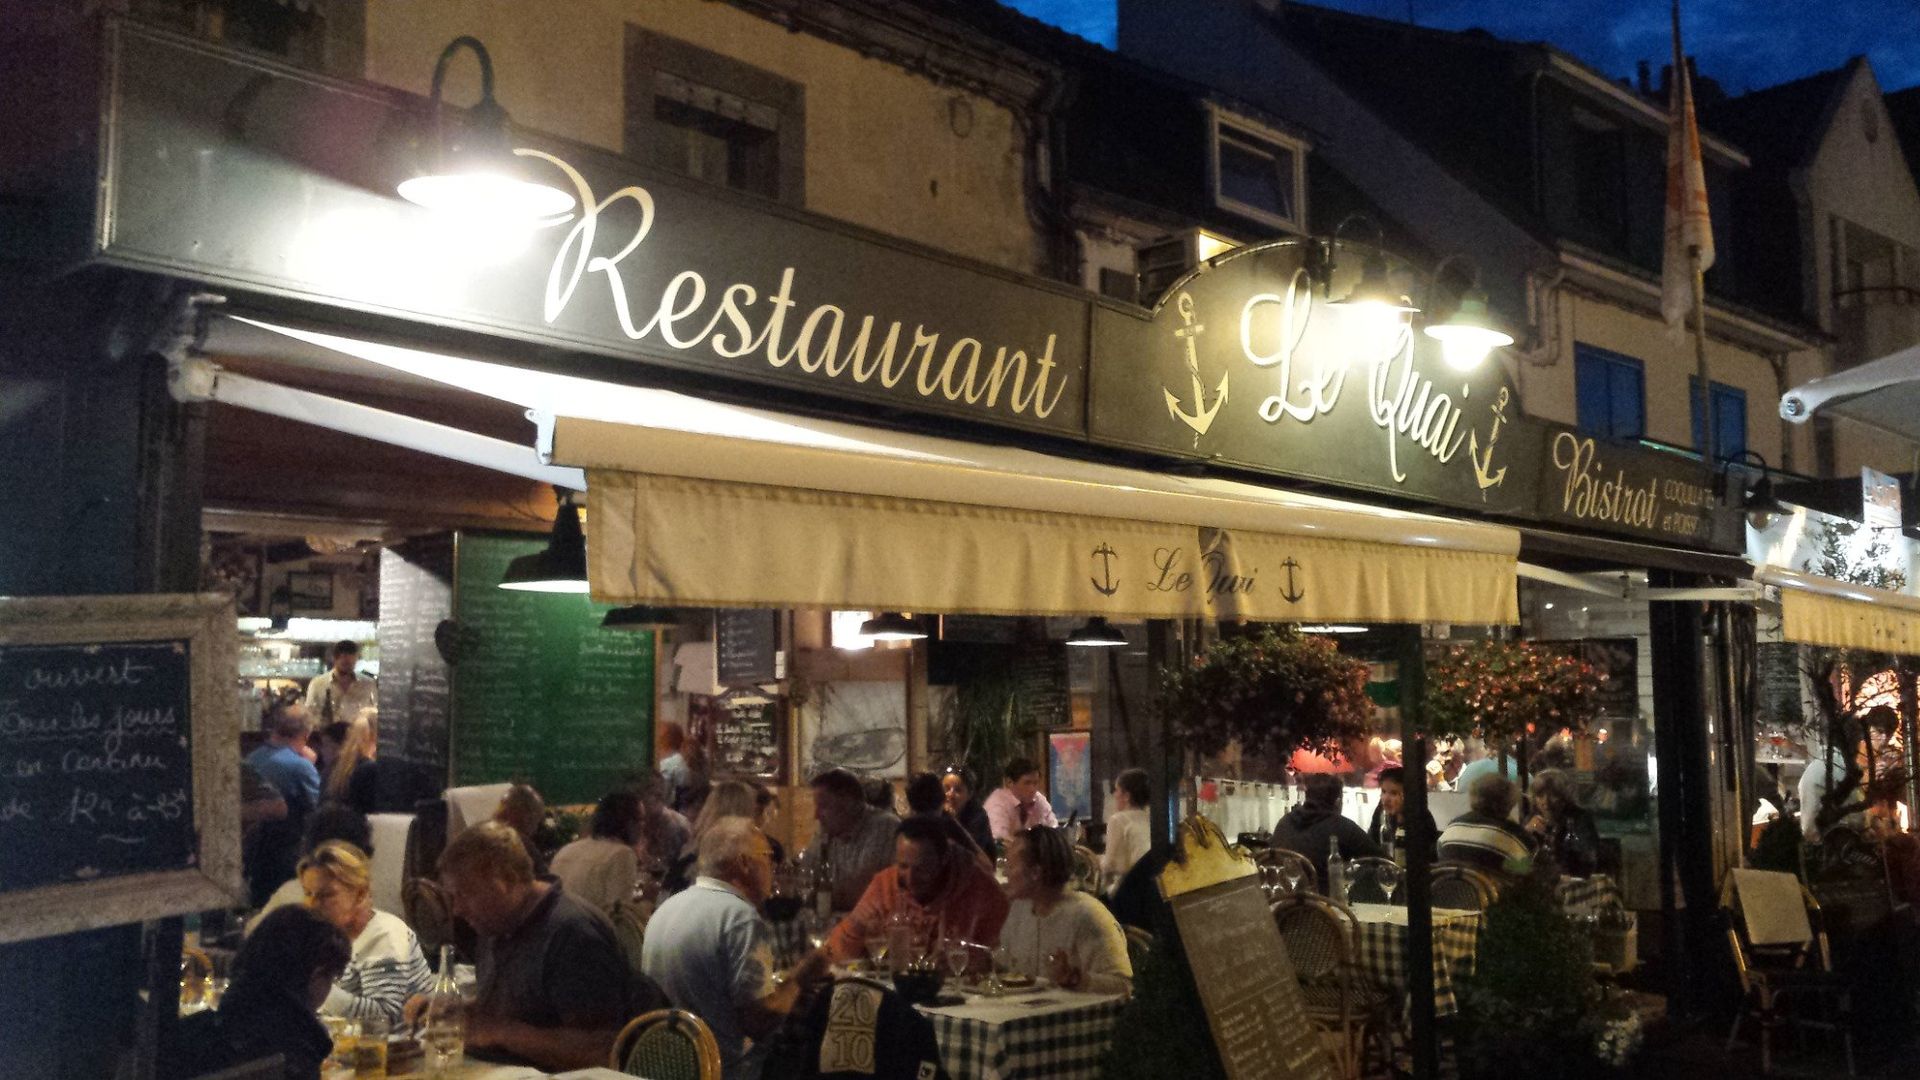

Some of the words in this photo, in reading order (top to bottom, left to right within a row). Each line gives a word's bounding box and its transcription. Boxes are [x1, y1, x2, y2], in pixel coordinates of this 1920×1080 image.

[513, 147, 1067, 419] Restaurant
[1240, 267, 1348, 424] Le
[1367, 295, 1466, 483] Quai
[1552, 431, 1661, 529] Bistrot
[1147, 547, 1194, 592] Le
